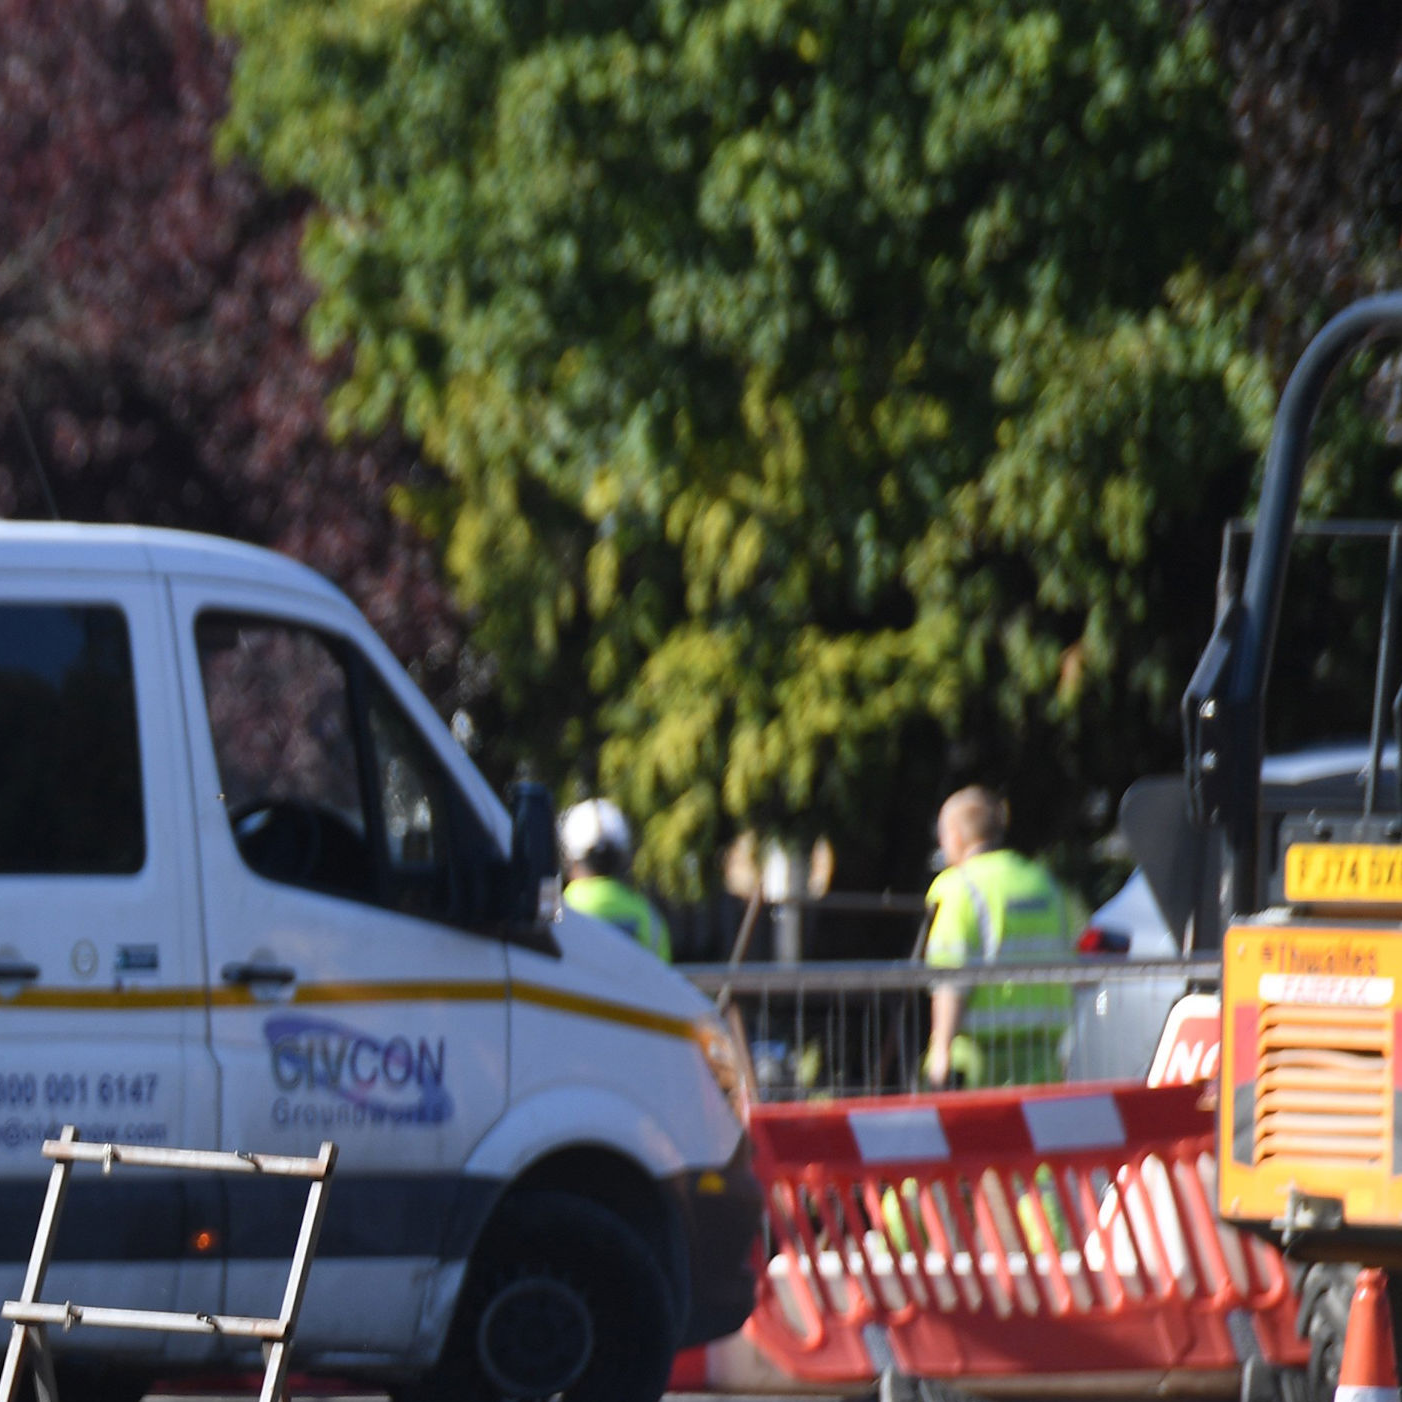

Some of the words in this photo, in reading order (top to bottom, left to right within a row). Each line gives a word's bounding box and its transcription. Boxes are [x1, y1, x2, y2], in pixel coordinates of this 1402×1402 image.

[1276, 938, 1379, 979] Thwaites
[270, 1033, 446, 1092] CIVCON
[43, 1072, 89, 1107] 001
[98, 1072, 159, 1107] 6147
